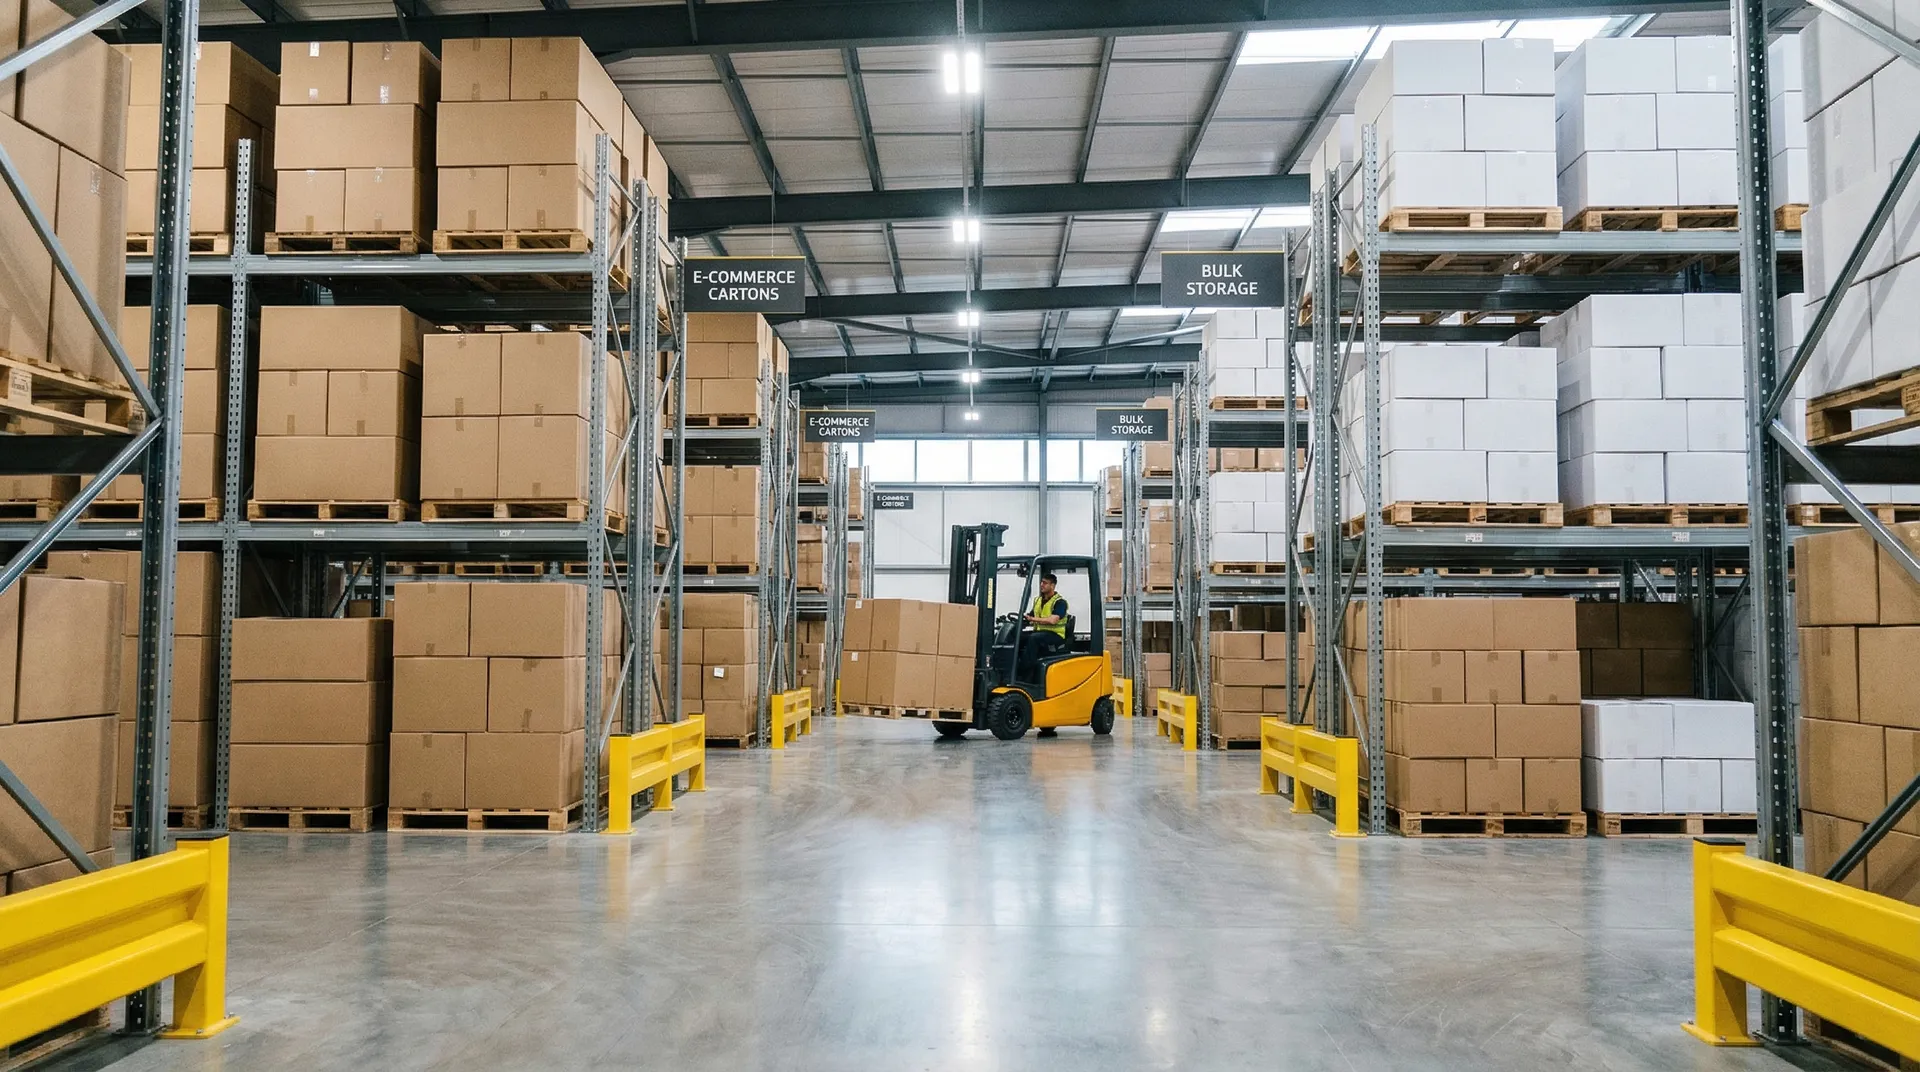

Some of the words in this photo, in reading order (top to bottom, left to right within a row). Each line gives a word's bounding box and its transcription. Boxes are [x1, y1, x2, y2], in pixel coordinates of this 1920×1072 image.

[1202, 264, 1243, 278] BULK
[694, 271, 796, 284] E-COMMERCE
[1187, 282, 1258, 295] STORAGE
[708, 288, 779, 301] CARTONS
[809, 417, 869, 426] E-COMMERCE
[1120, 415, 1144, 424] BULK
[818, 427, 861, 436] CARTONS
[1111, 425, 1153, 434] STORAGE
